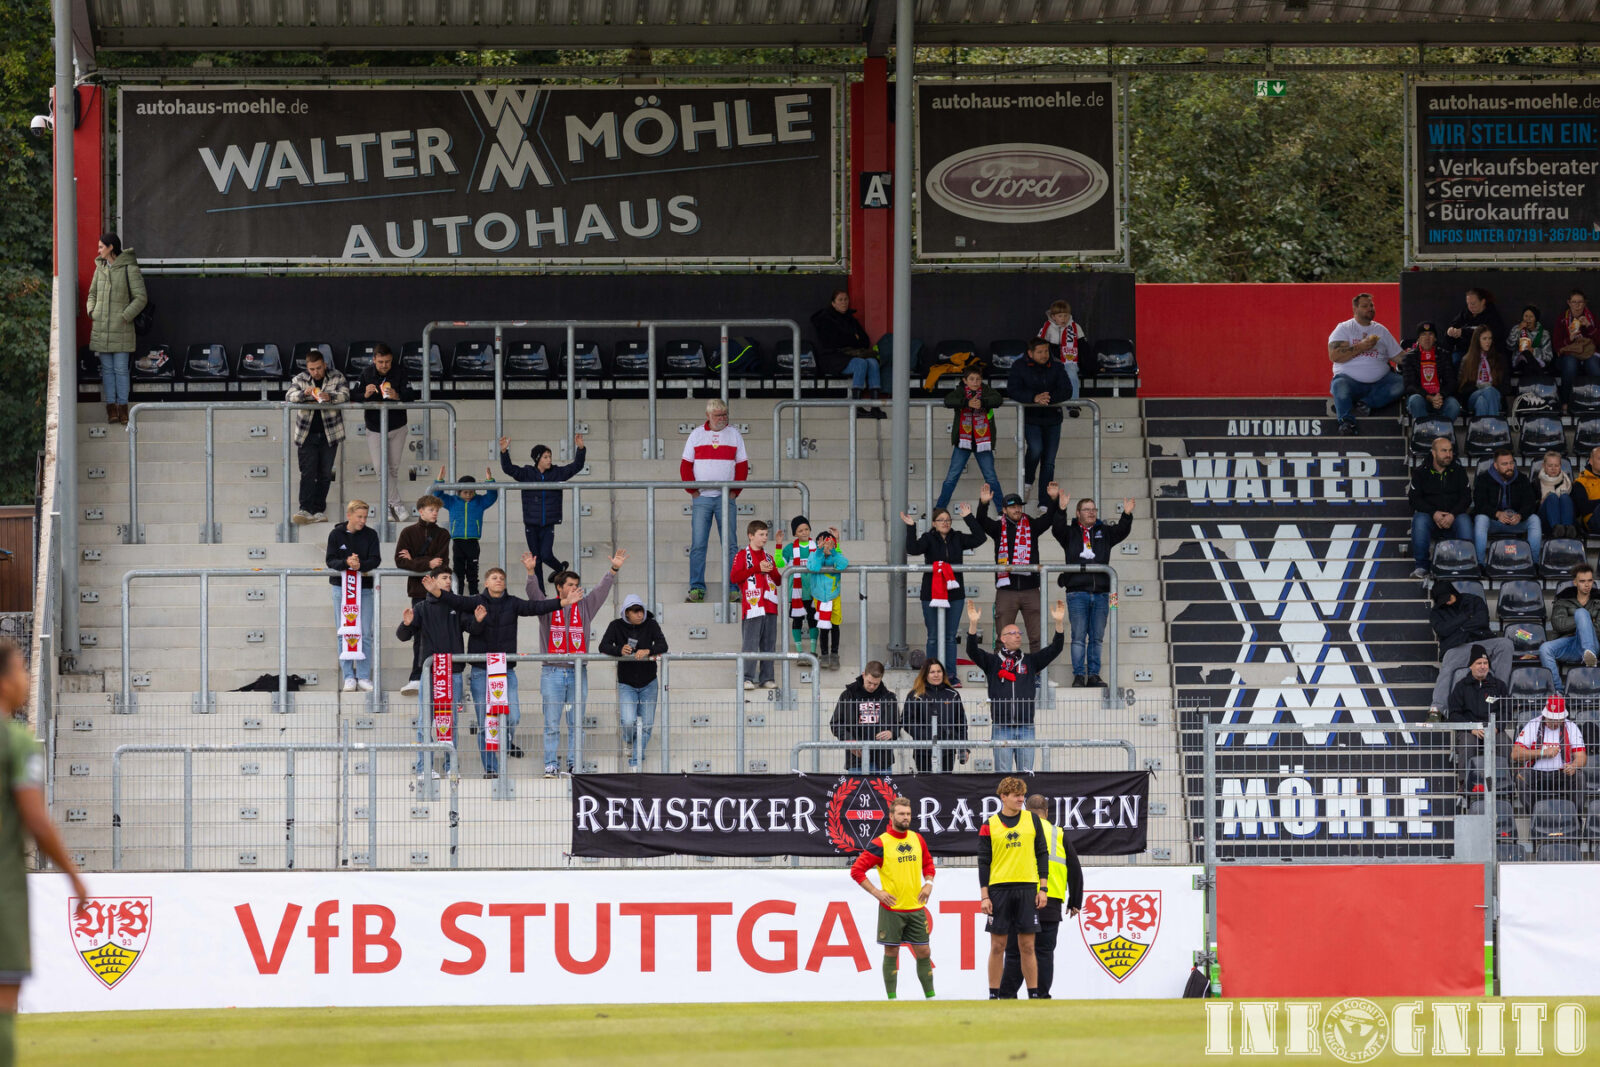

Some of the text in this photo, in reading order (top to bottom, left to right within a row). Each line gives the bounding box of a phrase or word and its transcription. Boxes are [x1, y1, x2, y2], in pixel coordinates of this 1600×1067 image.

[136, 97, 309, 115] autohaus-moehle.de
[931, 90, 1105, 110] autohaus-moehle.de
[1428, 92, 1600, 111] autohaus-moehle.de
[199, 93, 815, 195] WALTER MÖHLE
[1428, 122, 1599, 145] WIR STELLEN EIN:
[1439, 157, 1599, 176] Verkaufsberater
[864, 175, 888, 205] A
[970, 160, 1063, 199] Ford
[1440, 180, 1586, 198] Servicemeister
[1440, 202, 1570, 221] Bürokauffrau
[342, 195, 699, 259] AUTOHAUS
[1428, 229, 1464, 244] INFOS
[1465, 228, 1505, 243] UNTER
[1226, 419, 1322, 437] AUTOHAUS
[1181, 451, 1387, 506] WALTER
[347, 574, 356, 599] VfB
[435, 679, 447, 700] VfB
[1221, 765, 1437, 838] MÖHLE
[576, 795, 820, 834] REMSECKER
[73, 900, 149, 939] VfB
[1082, 893, 1158, 934] VfB
[89, 939, 98, 947] 18
[233, 899, 982, 976] VfB STUTTGAT
[1098, 932, 1142, 940] 18 93
